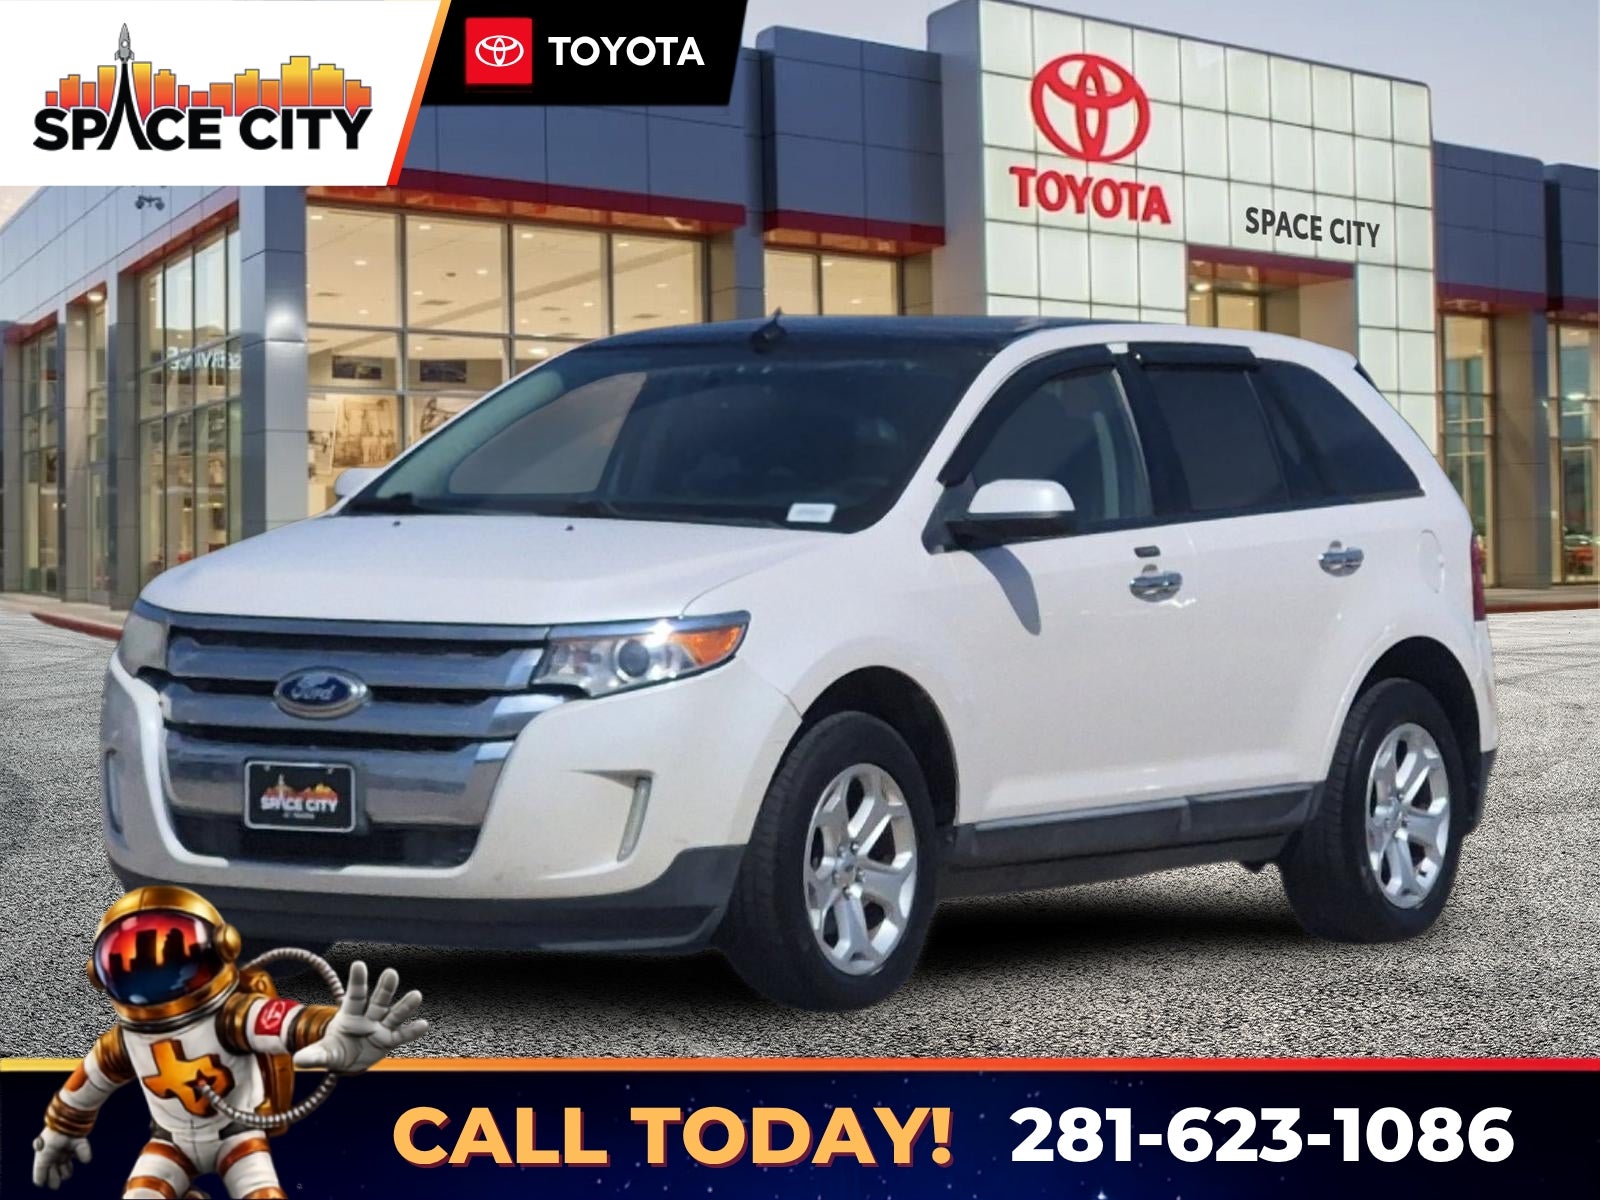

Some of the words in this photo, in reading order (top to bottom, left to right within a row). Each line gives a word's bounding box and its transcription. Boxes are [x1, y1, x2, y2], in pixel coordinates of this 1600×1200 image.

[1009, 166, 1171, 224] TOYOTA
[1245, 206, 1322, 241] SPACE
[1329, 218, 1380, 248] CITY
[291, 676, 336, 700] Ford
[260, 795, 303, 811] SPACE
[305, 798, 338, 812] CITY
